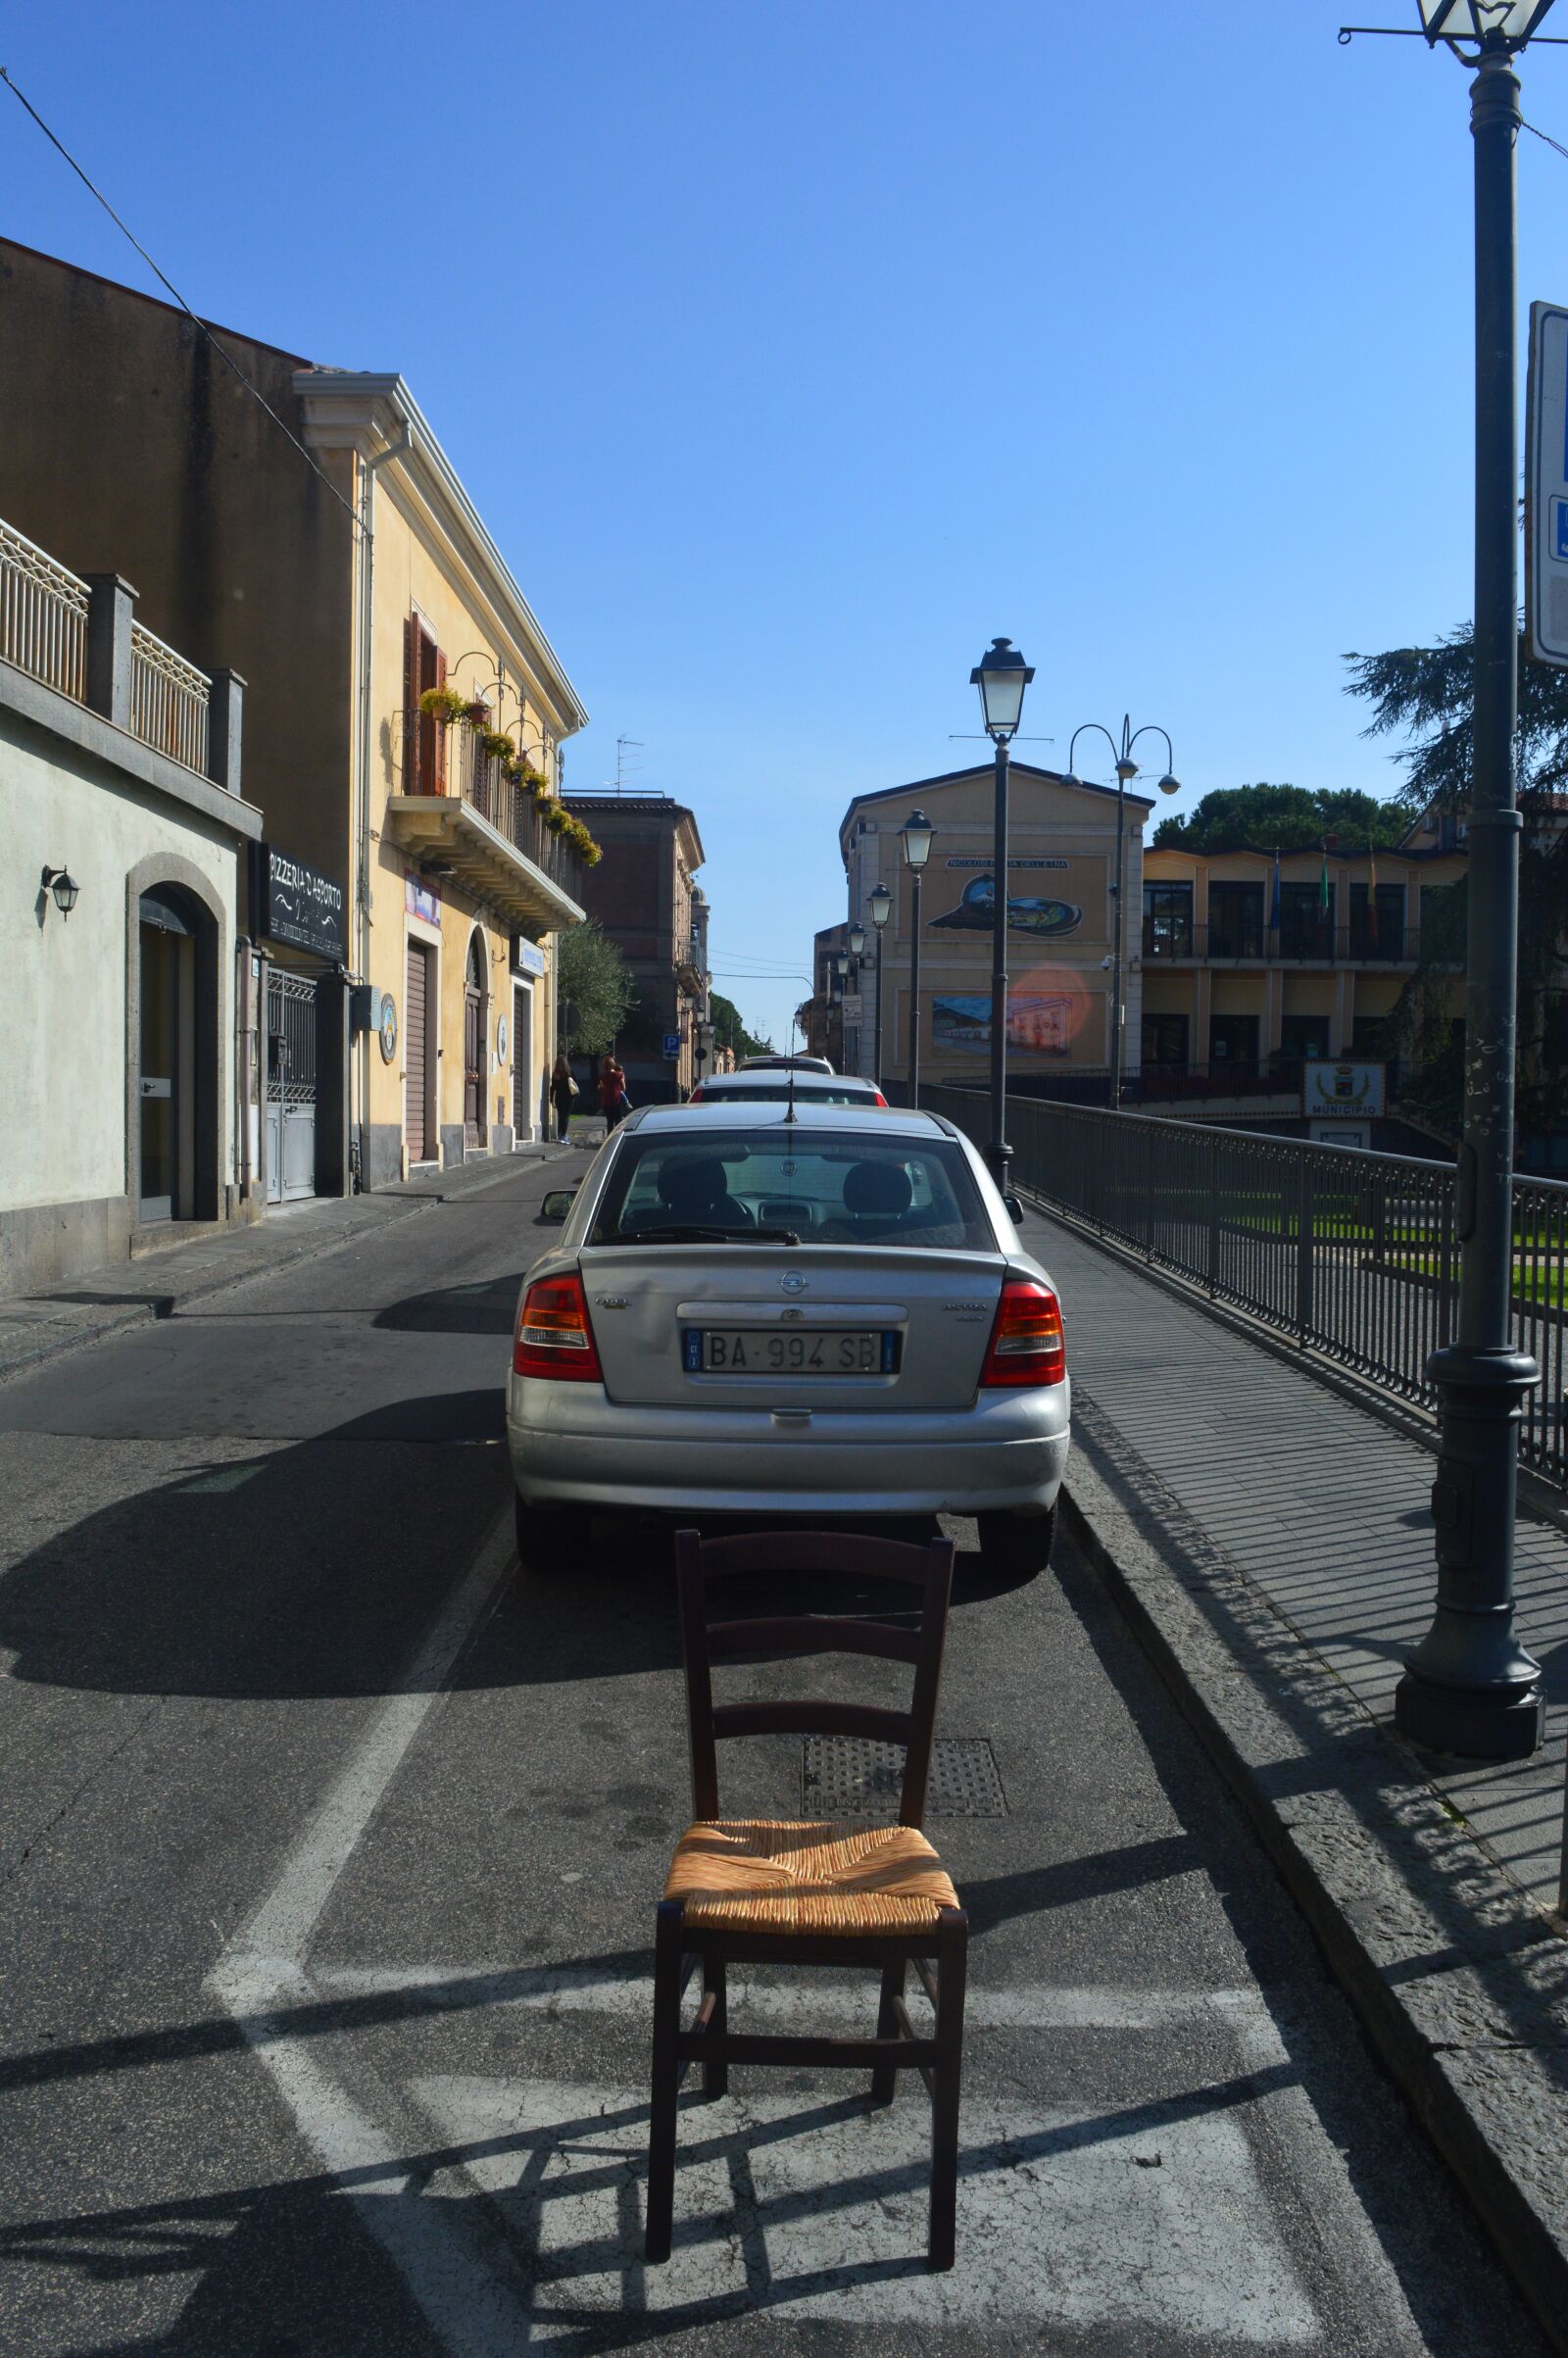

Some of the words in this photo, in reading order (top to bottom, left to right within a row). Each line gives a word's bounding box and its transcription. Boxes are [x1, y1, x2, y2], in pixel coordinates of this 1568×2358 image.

[270, 851, 306, 894] PIZZERIA
[666, 1037, 677, 1049] P
[1312, 1105, 1376, 1114] MUNICIPIO
[942, 1302, 988, 1310] ASTRA
[710, 1336, 747, 1367] BA
[767, 1337, 825, 1367] 994
[839, 1338, 876, 1368] SB
